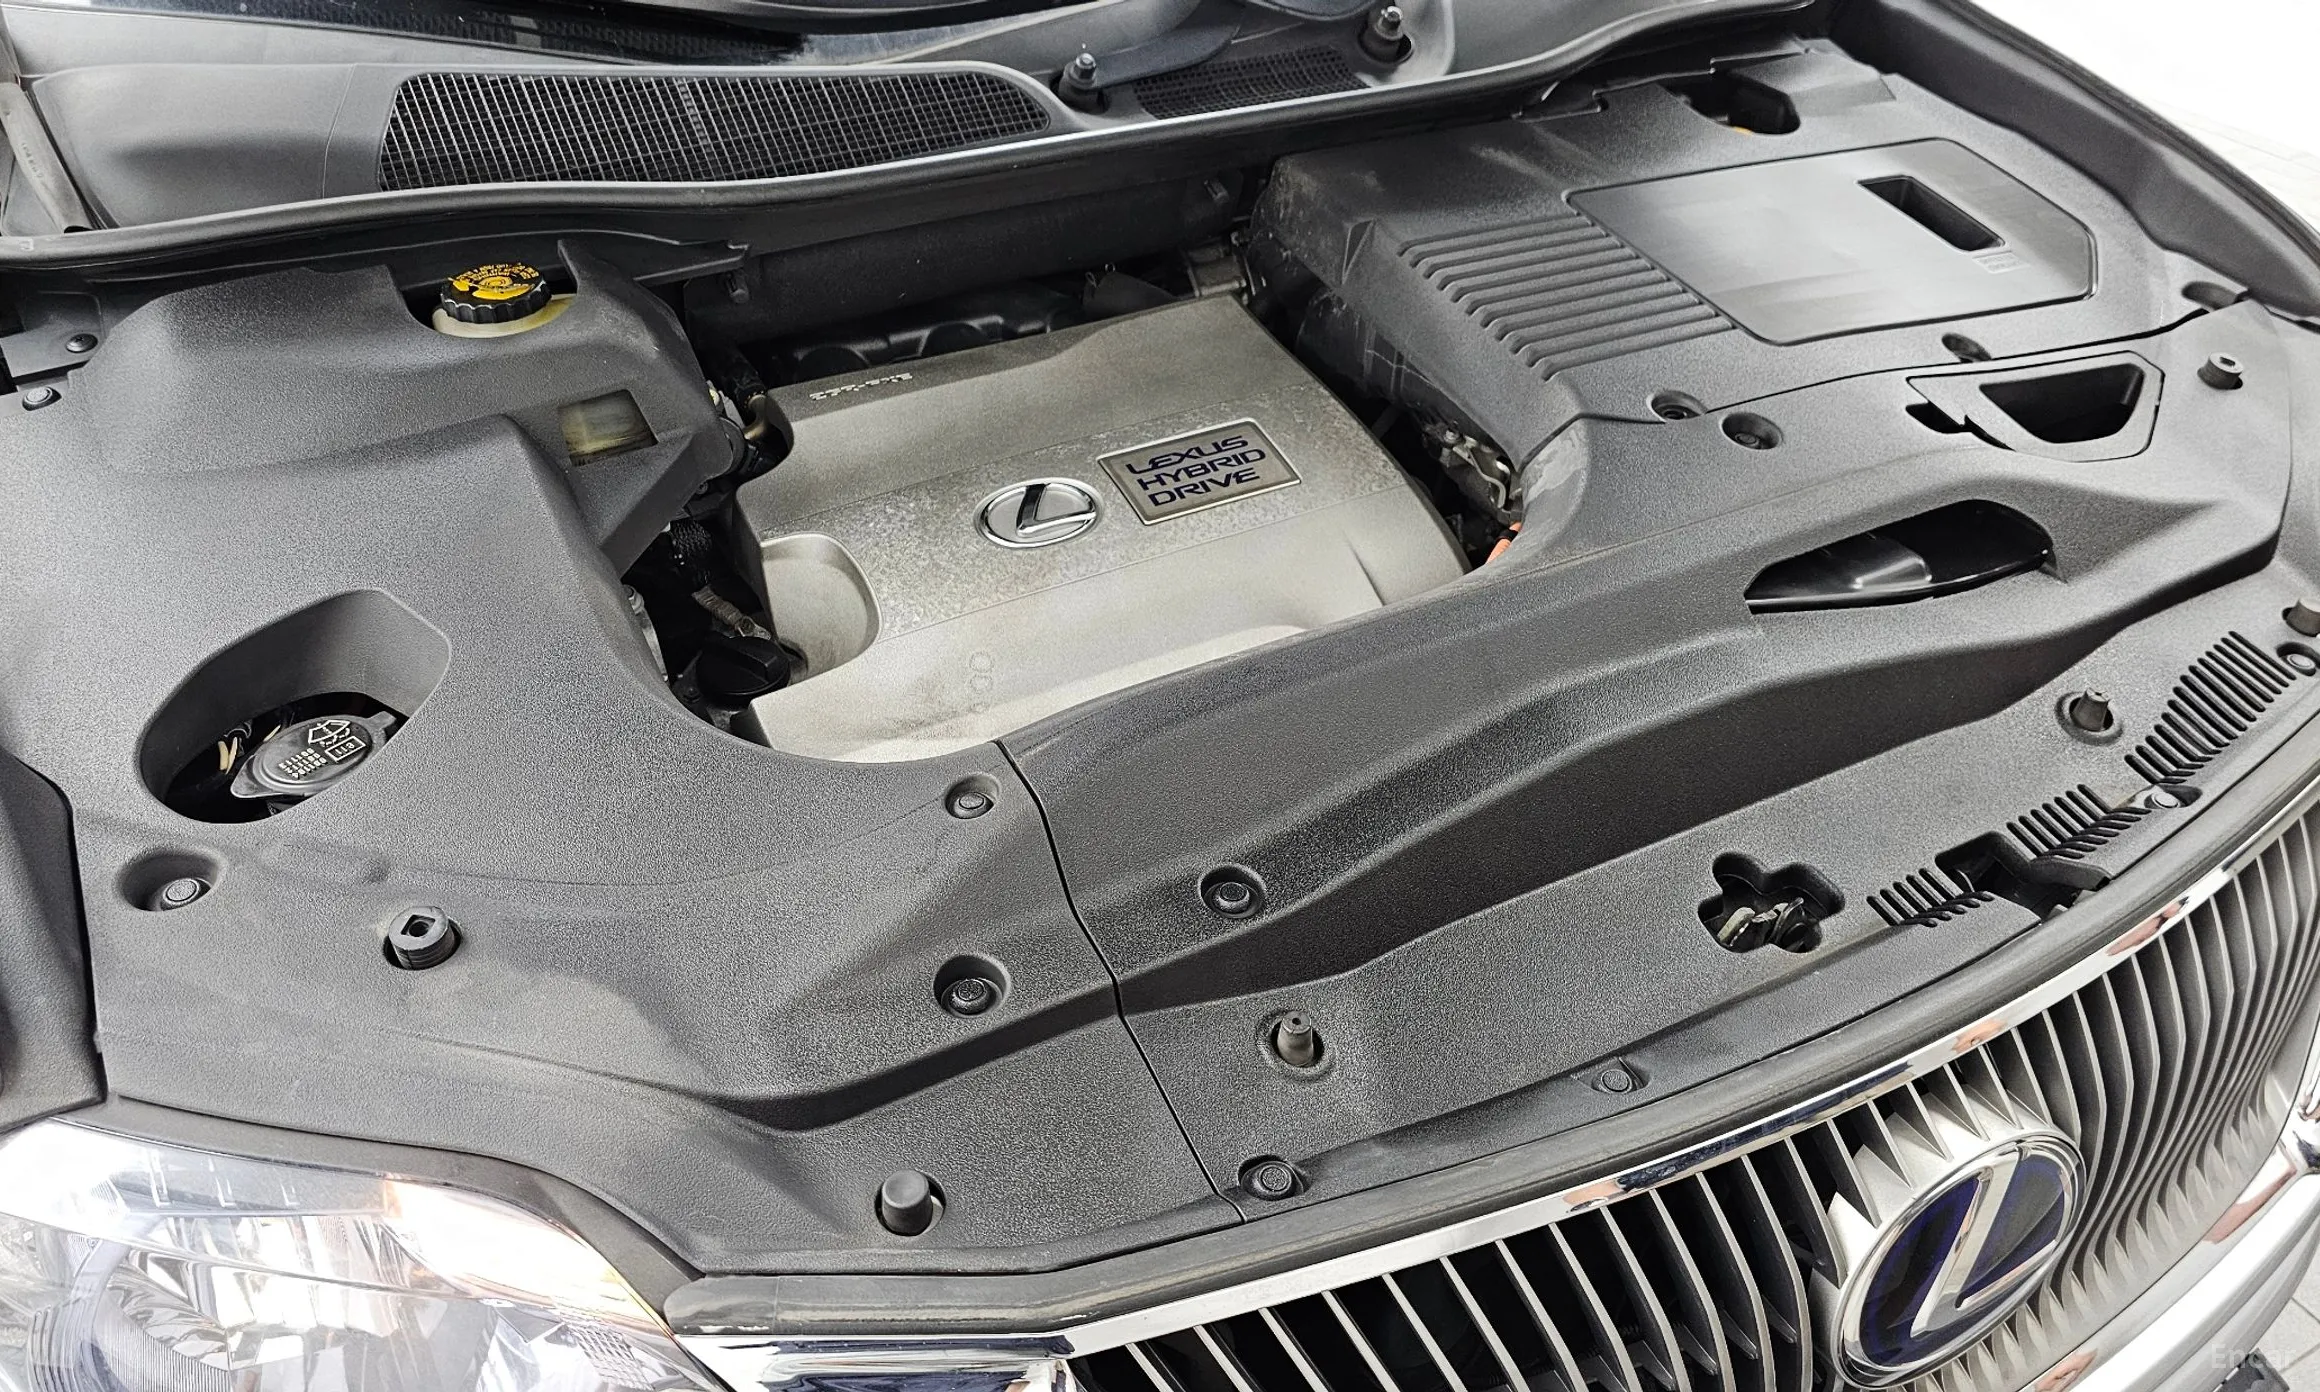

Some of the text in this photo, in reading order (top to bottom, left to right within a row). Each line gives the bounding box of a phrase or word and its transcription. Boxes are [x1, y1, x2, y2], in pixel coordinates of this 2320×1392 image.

[1125, 435, 1249, 475] LEXUS
[1136, 448, 1266, 491] HYBRID
[1148, 467, 1260, 507] DRIVE
